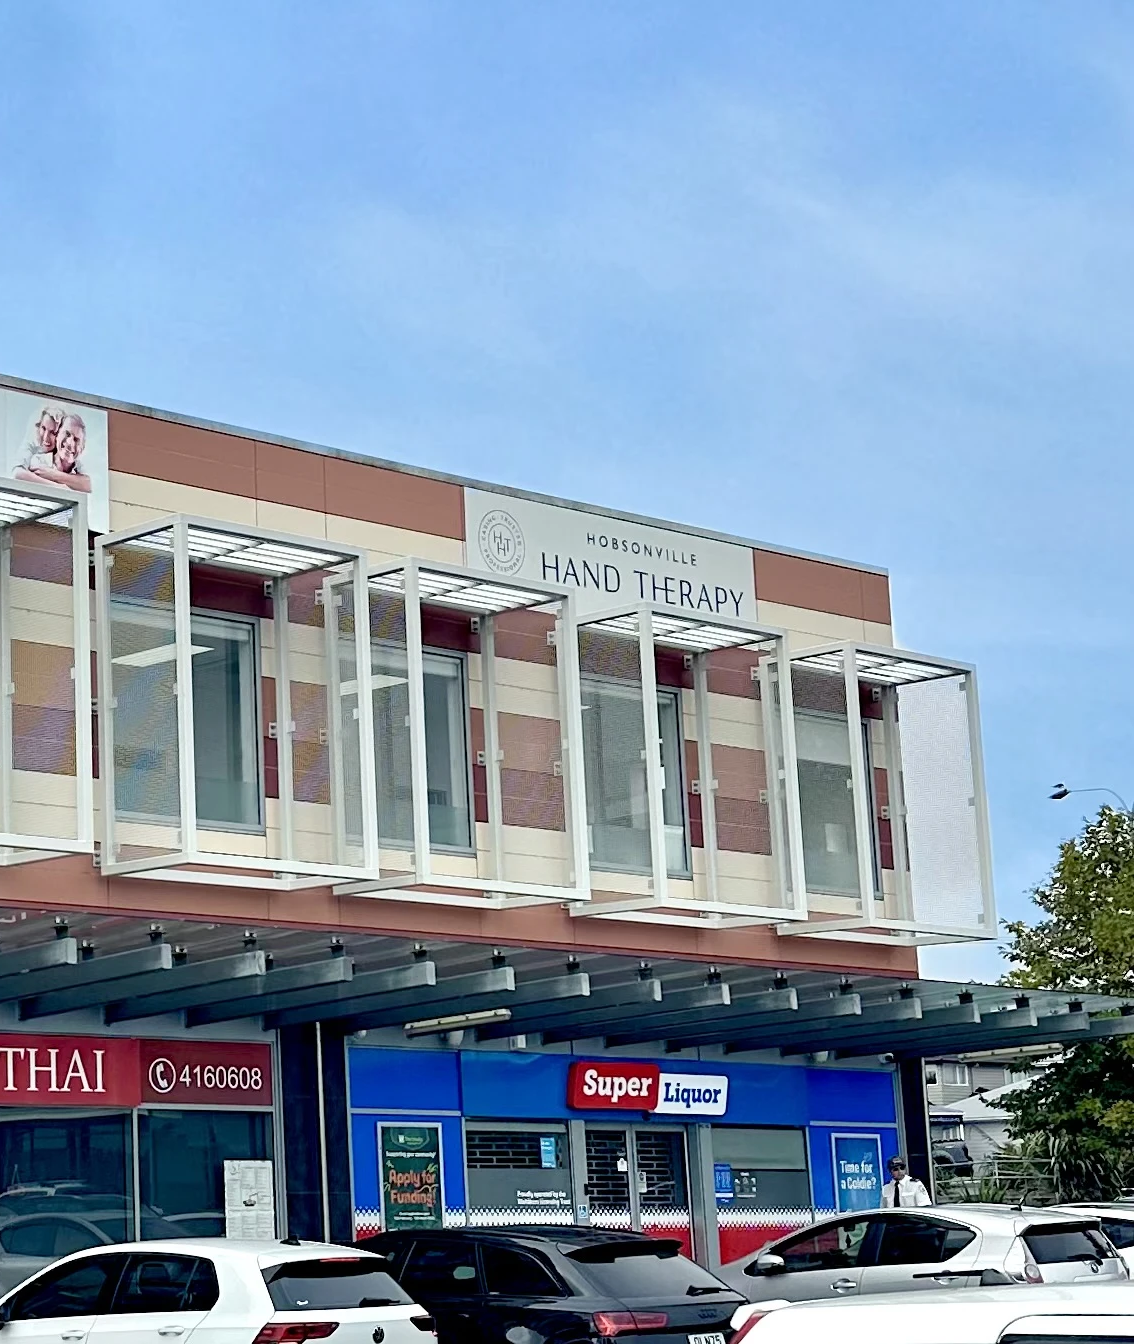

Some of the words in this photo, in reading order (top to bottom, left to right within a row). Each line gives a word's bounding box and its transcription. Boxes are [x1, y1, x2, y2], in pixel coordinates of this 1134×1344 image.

[586, 532, 697, 567] HOBSONVILLE
[541, 551, 621, 594] HAND
[633, 569, 744, 617] THERAPY
[179, 1064, 263, 1090] 4160608
[582, 1068, 653, 1103] Super
[663, 1082, 722, 1109] Liquor
[389, 1169, 420, 1187] Apply
[421, 1169, 437, 1184] for
[861, 1160, 874, 1174] for
